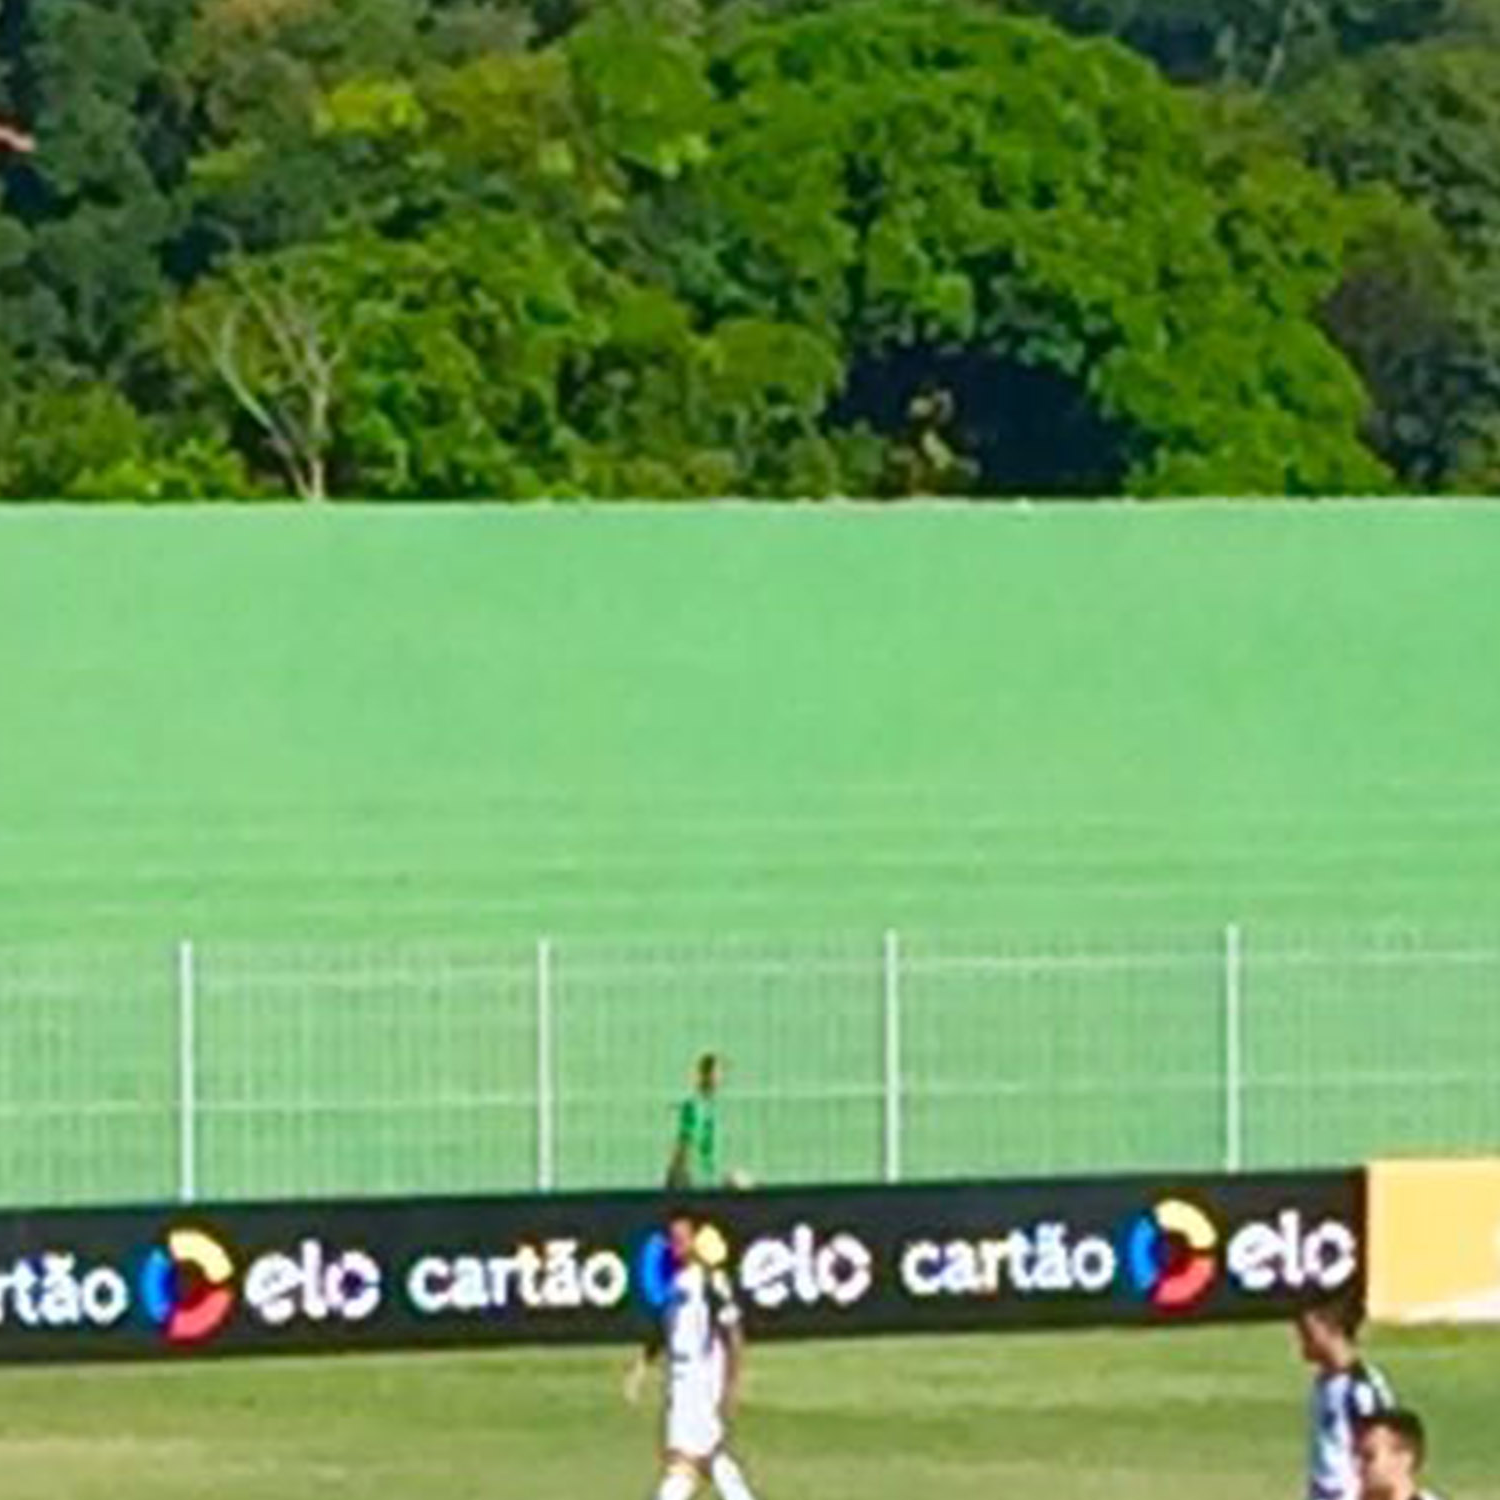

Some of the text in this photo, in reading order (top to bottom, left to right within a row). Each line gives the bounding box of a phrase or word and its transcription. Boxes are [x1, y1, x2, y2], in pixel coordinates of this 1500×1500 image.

[244, 1238, 381, 1323] elo
[407, 1237, 628, 1312] cartão
[739, 1222, 871, 1308] elo
[900, 1221, 1116, 1295] cartão
[1226, 1209, 1355, 1289] elo
